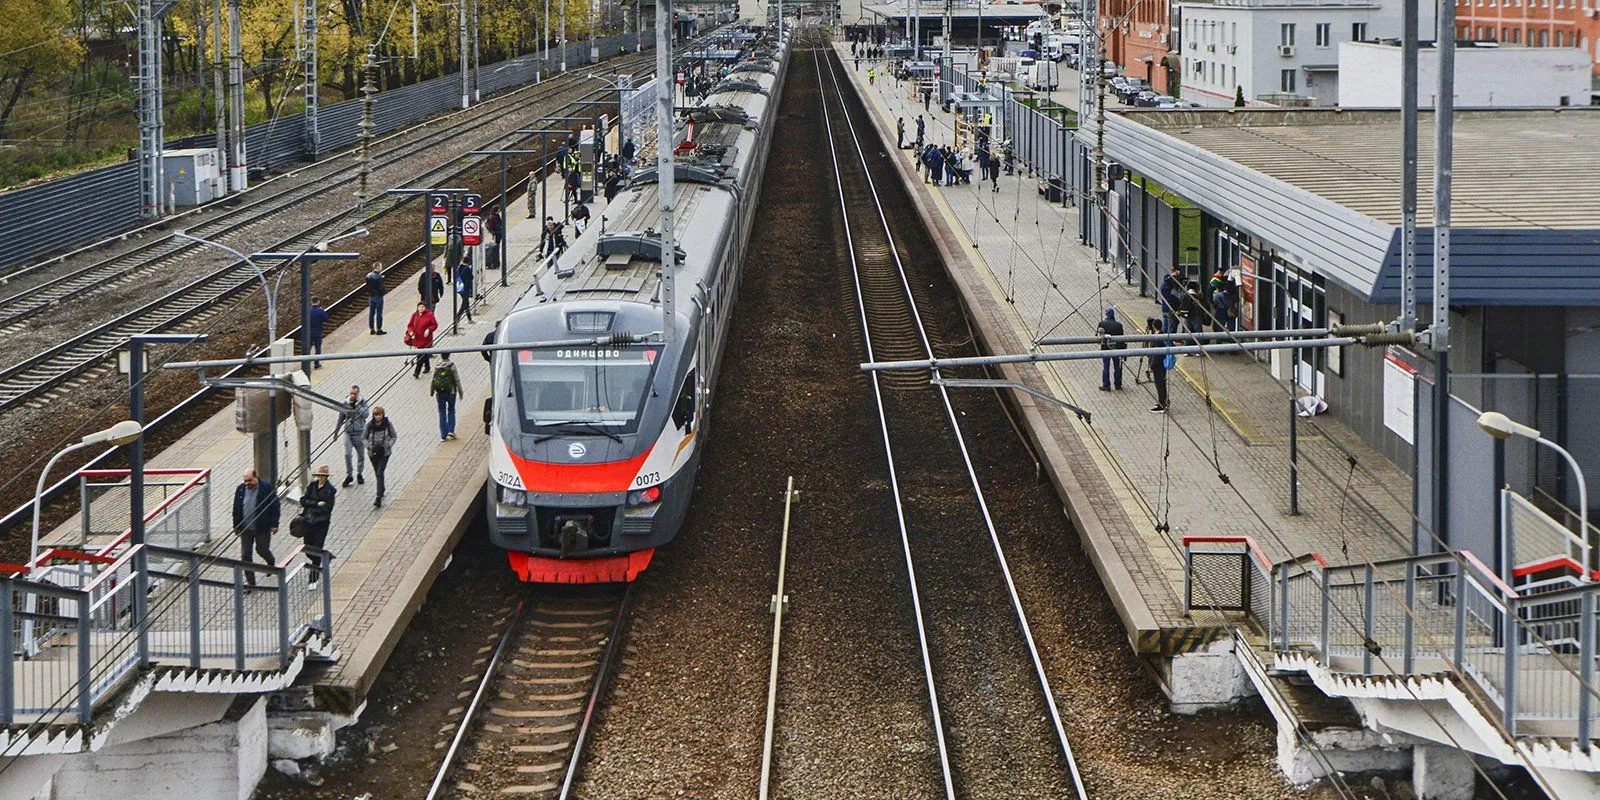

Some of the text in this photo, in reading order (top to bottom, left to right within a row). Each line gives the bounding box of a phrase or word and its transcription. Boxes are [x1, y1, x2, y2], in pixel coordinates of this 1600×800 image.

[434, 197, 442, 207] 2
[467, 197, 475, 207] 5
[557, 350, 619, 358] ОДИНЦОВО
[498, 471, 522, 488] ЭП2Д
[636, 472, 661, 487] 0073
